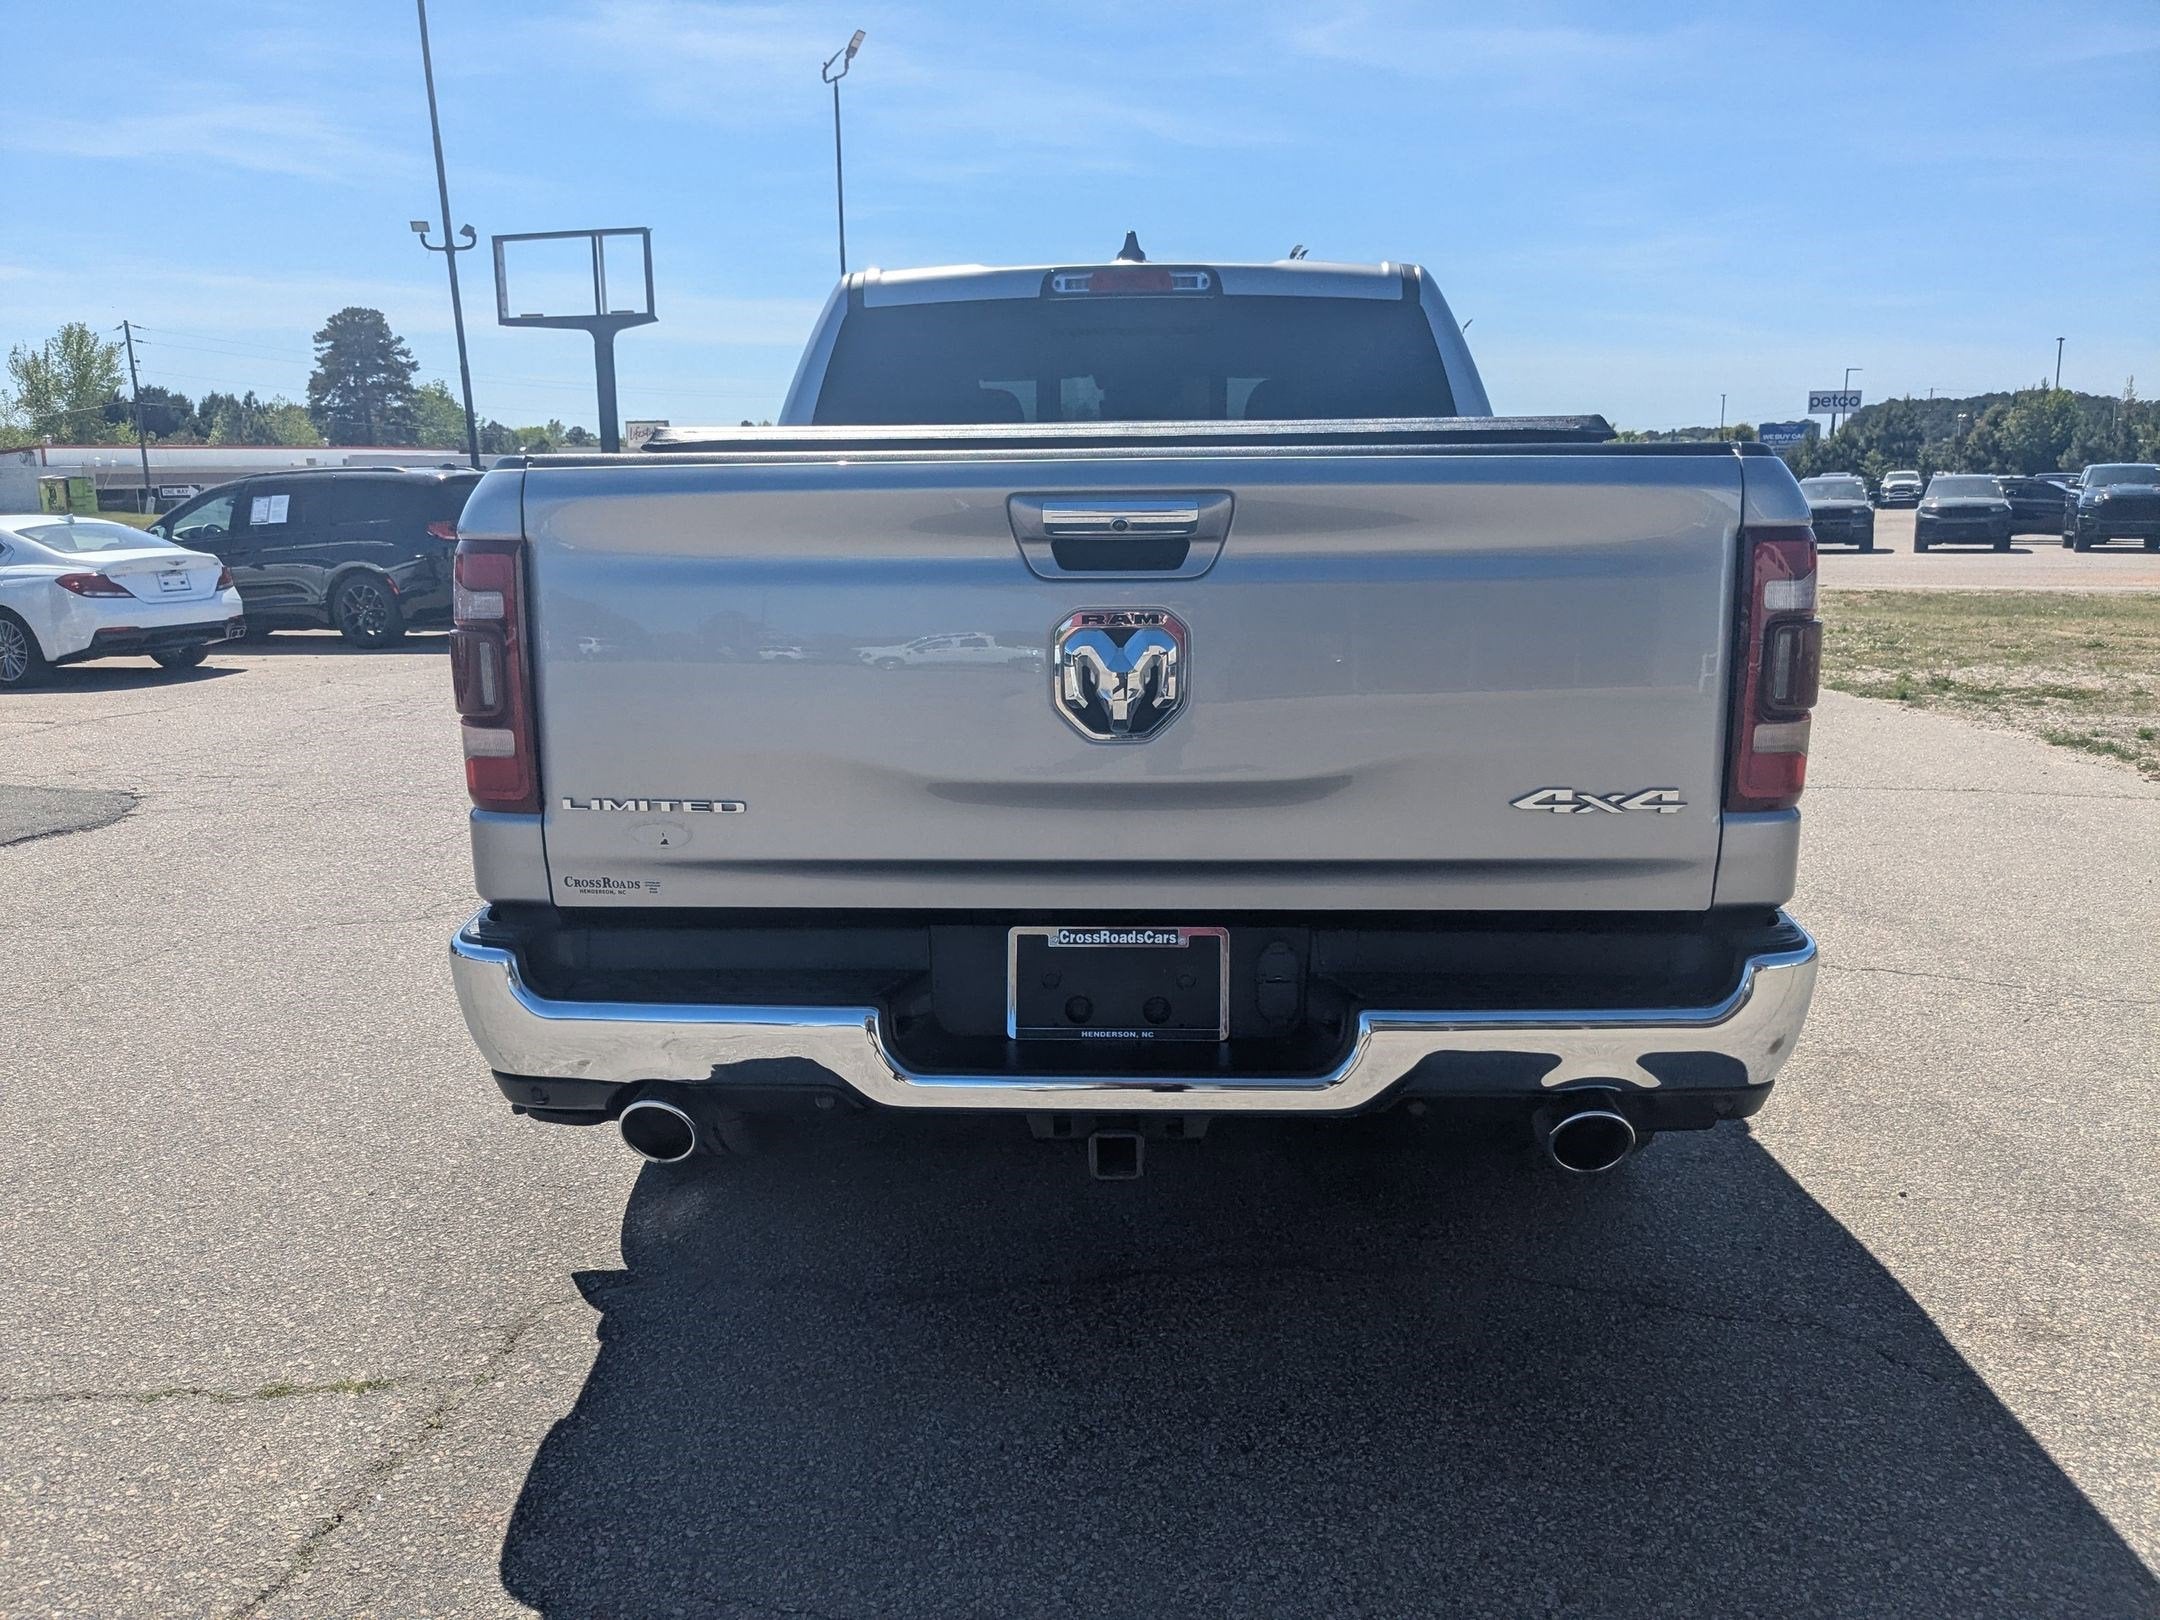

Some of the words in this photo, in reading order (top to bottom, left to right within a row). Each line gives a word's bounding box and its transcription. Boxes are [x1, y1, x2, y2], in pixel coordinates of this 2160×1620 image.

[1810, 394, 1860, 410] petco
[1081, 613, 1160, 625] RAM
[562, 797, 747, 814] LIMITED
[1059, 930, 1177, 944] CrossRoadsCars
